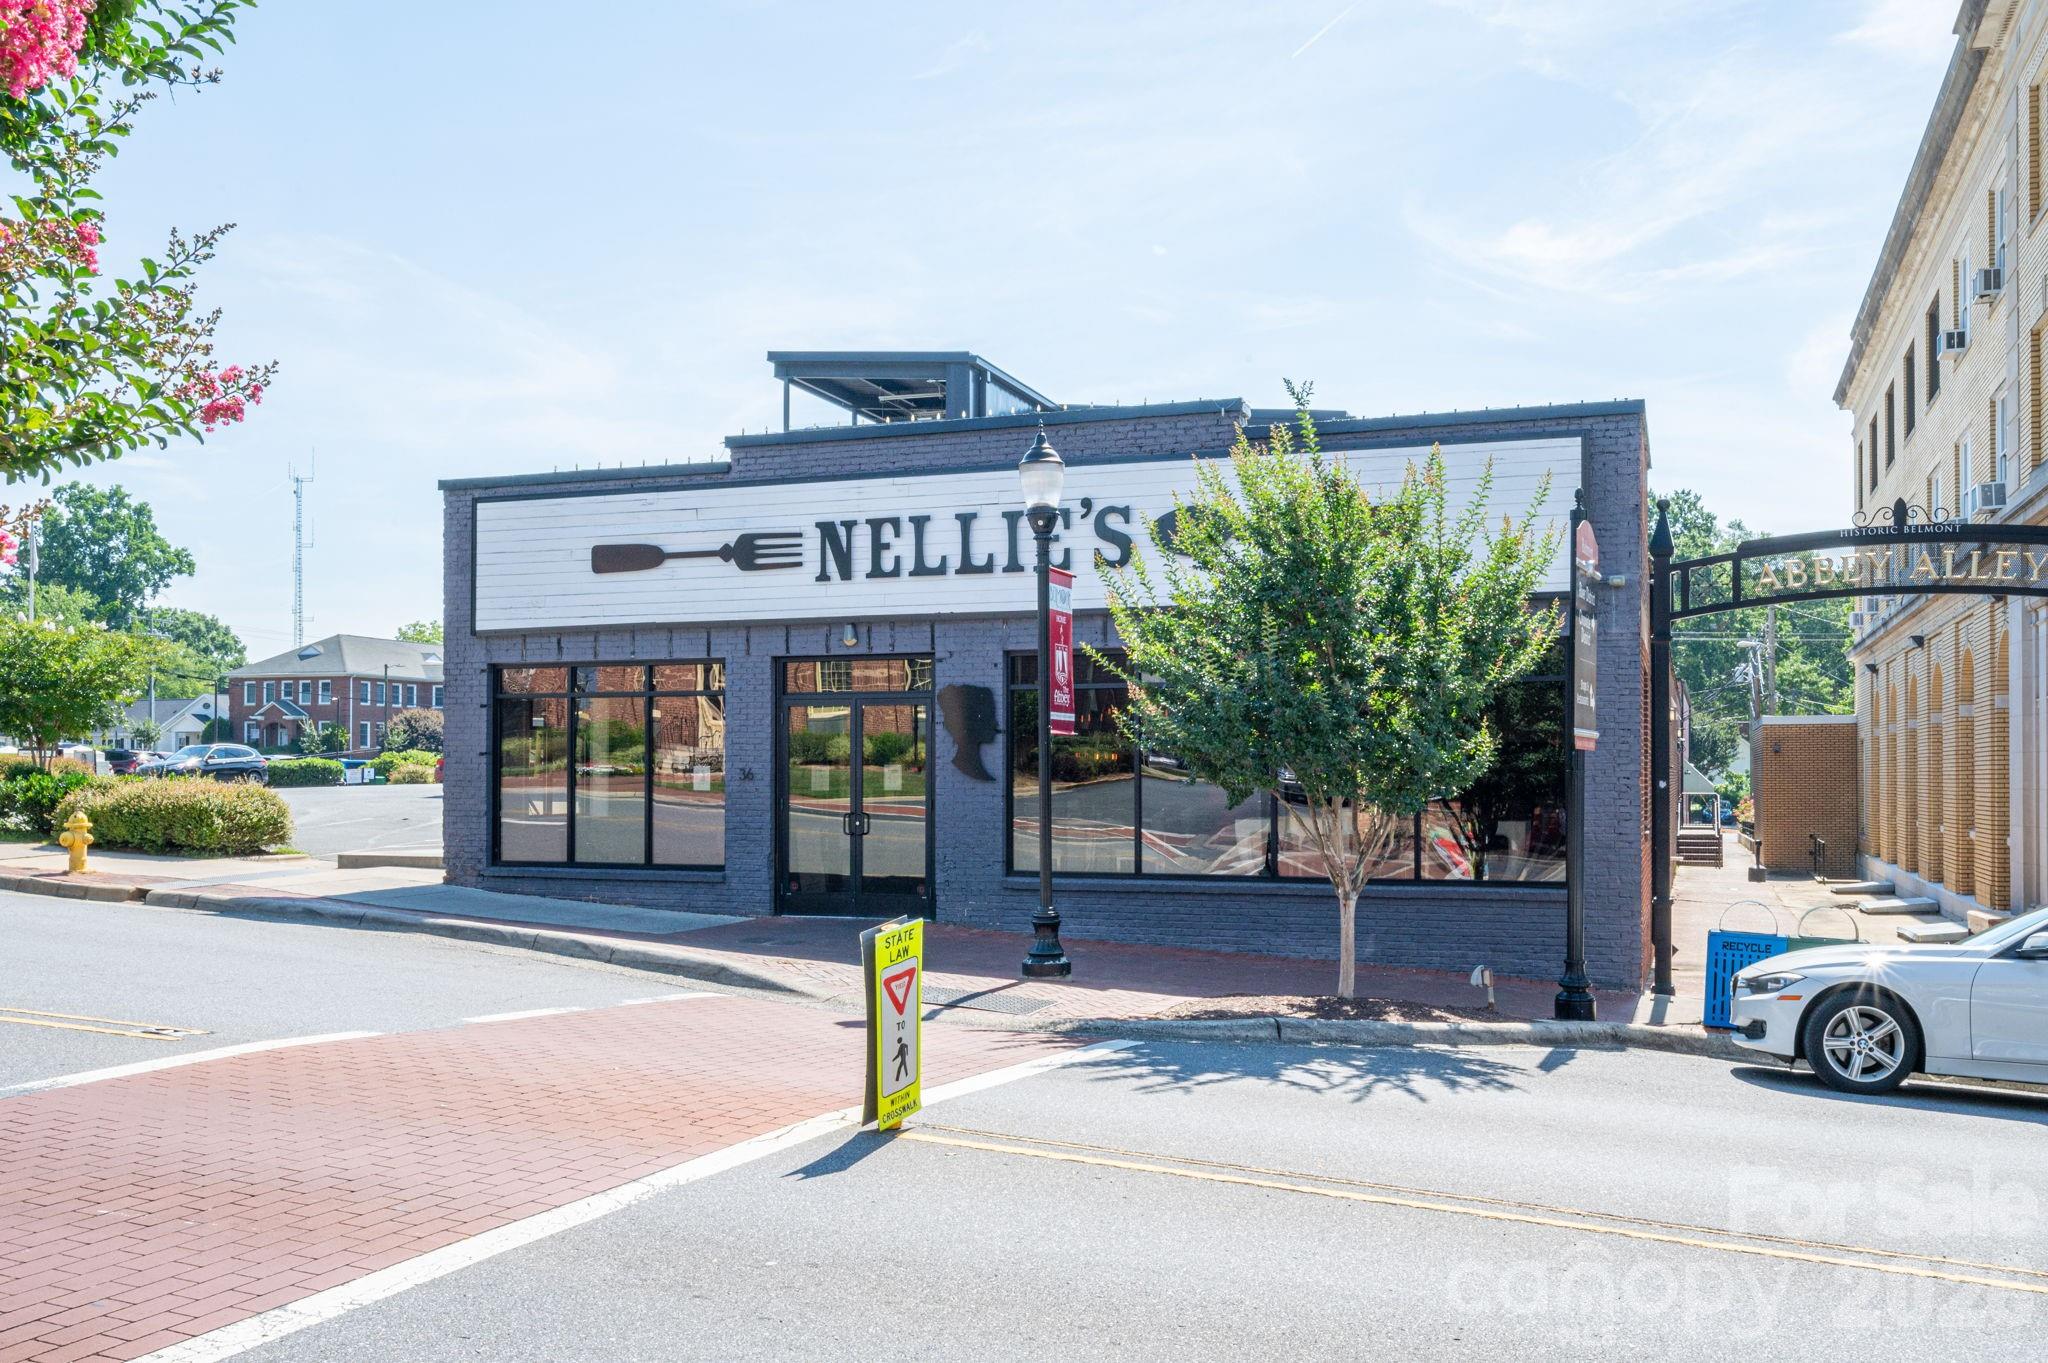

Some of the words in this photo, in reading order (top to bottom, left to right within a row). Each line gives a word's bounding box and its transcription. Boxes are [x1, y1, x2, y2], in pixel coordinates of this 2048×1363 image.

[815, 497, 1133, 582] NELLIE'S
[1840, 526, 1898, 538] HISTORIC
[1902, 524, 1962, 535] BELMONT
[1755, 551, 1893, 592] ABBEY
[1909, 550, 2048, 582] ALLEY
[885, 928, 915, 949] STATE
[1721, 940, 1772, 953] RECYCLE
[889, 945, 910, 963] LAW
[896, 1020, 906, 1032] TO
[890, 1090, 911, 1108] WITHIN
[882, 1098, 917, 1123] CROSSWALK
